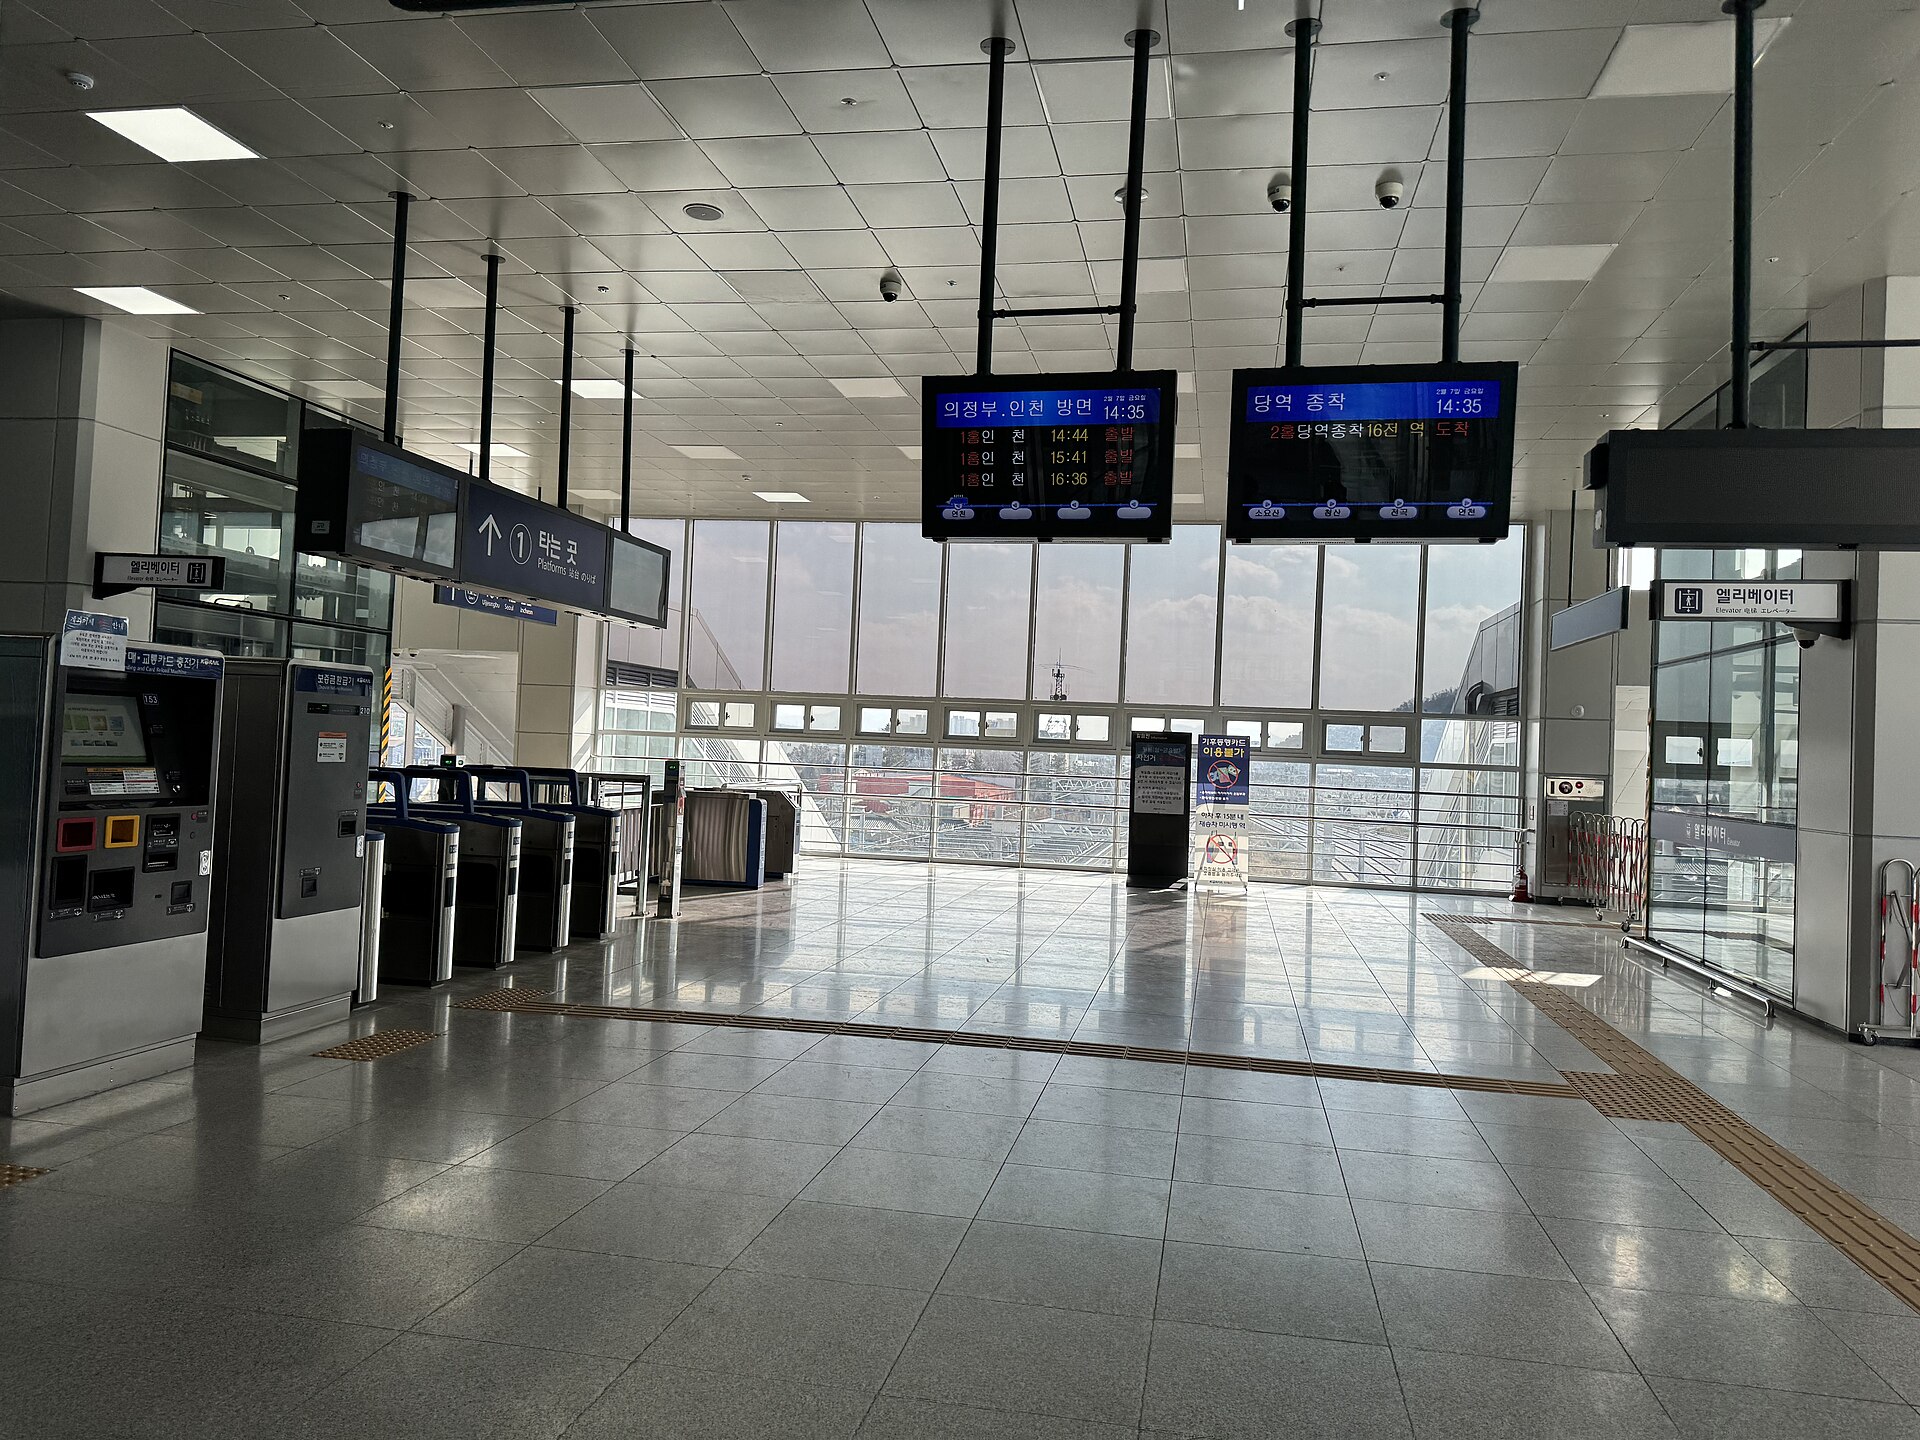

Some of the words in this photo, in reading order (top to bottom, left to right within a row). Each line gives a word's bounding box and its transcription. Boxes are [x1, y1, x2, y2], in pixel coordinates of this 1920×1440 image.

[1464, 387, 1484, 395] 금요일
[1057, 398, 1092, 416] 방면
[1254, 394, 1292, 413] 당역
[1306, 392, 1346, 412] 종착
[1436, 398, 1482, 414] 14:35
[1103, 404, 1145, 420] 14:35
[1051, 428, 1089, 443] 14:44
[1104, 426, 1133, 442] 출발
[1410, 422, 1424, 437] 역
[1435, 421, 1470, 437] 도착
[1050, 450, 1087, 465] 15:41
[1104, 448, 1133, 464] 출발
[1050, 472, 1088, 486] 16:36
[1103, 470, 1132, 486] 출발
[1254, 509, 1280, 518] 소요산
[1391, 508, 1408, 517] 전곡
[1458, 508, 1476, 517] 연천
[517, 531, 524, 558] 1
[539, 530, 561, 560] 타는
[566, 540, 578, 566] 곳
[131, 560, 180, 575] 엘리베이터
[537, 557, 567, 576] Platforms
[1715, 587, 1795, 605] 엘리베이터
[504, 603, 515, 611] Seoul
[519, 607, 534, 616] Incheon
[176, 656, 199, 669] 충전기
[317, 673, 355, 687] 보증금환급기
[144, 695, 158, 704] 153
[1202, 738, 1246, 747] 기후동행카드
[1203, 747, 1245, 758] 이용불가
[1223, 813, 1236, 821] 15분
[1237, 813, 1244, 821] 내
[1694, 823, 1726, 845] 엘리베이터
